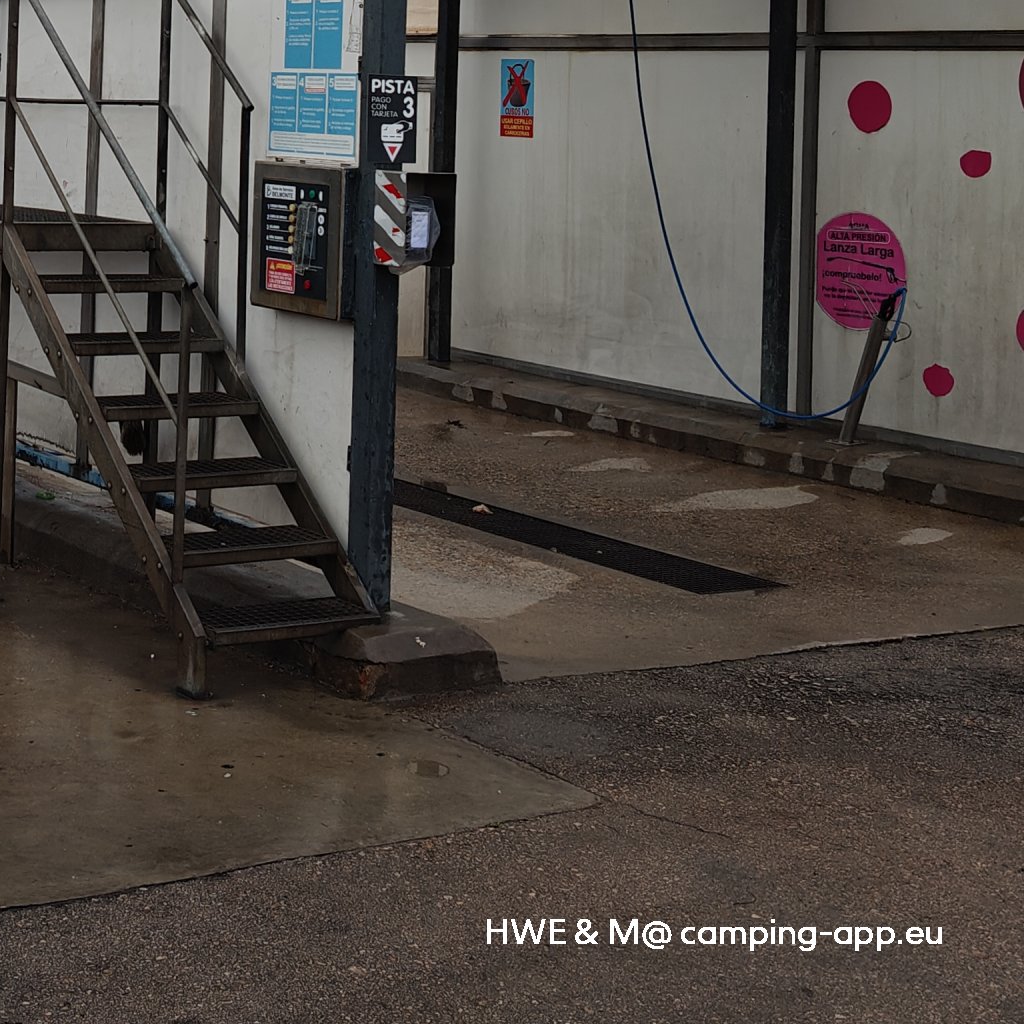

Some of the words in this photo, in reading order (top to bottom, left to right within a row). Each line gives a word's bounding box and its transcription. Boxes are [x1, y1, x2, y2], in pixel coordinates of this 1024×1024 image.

[272, 76, 277, 87] 3
[299, 77, 305, 87] 4
[329, 77, 335, 88] 5
[371, 78, 415, 95] PISTA
[402, 96, 415, 118] 3
[830, 231, 850, 241] ALTA
[823, 241, 857, 254] Lanza
[861, 243, 895, 259] Larga
